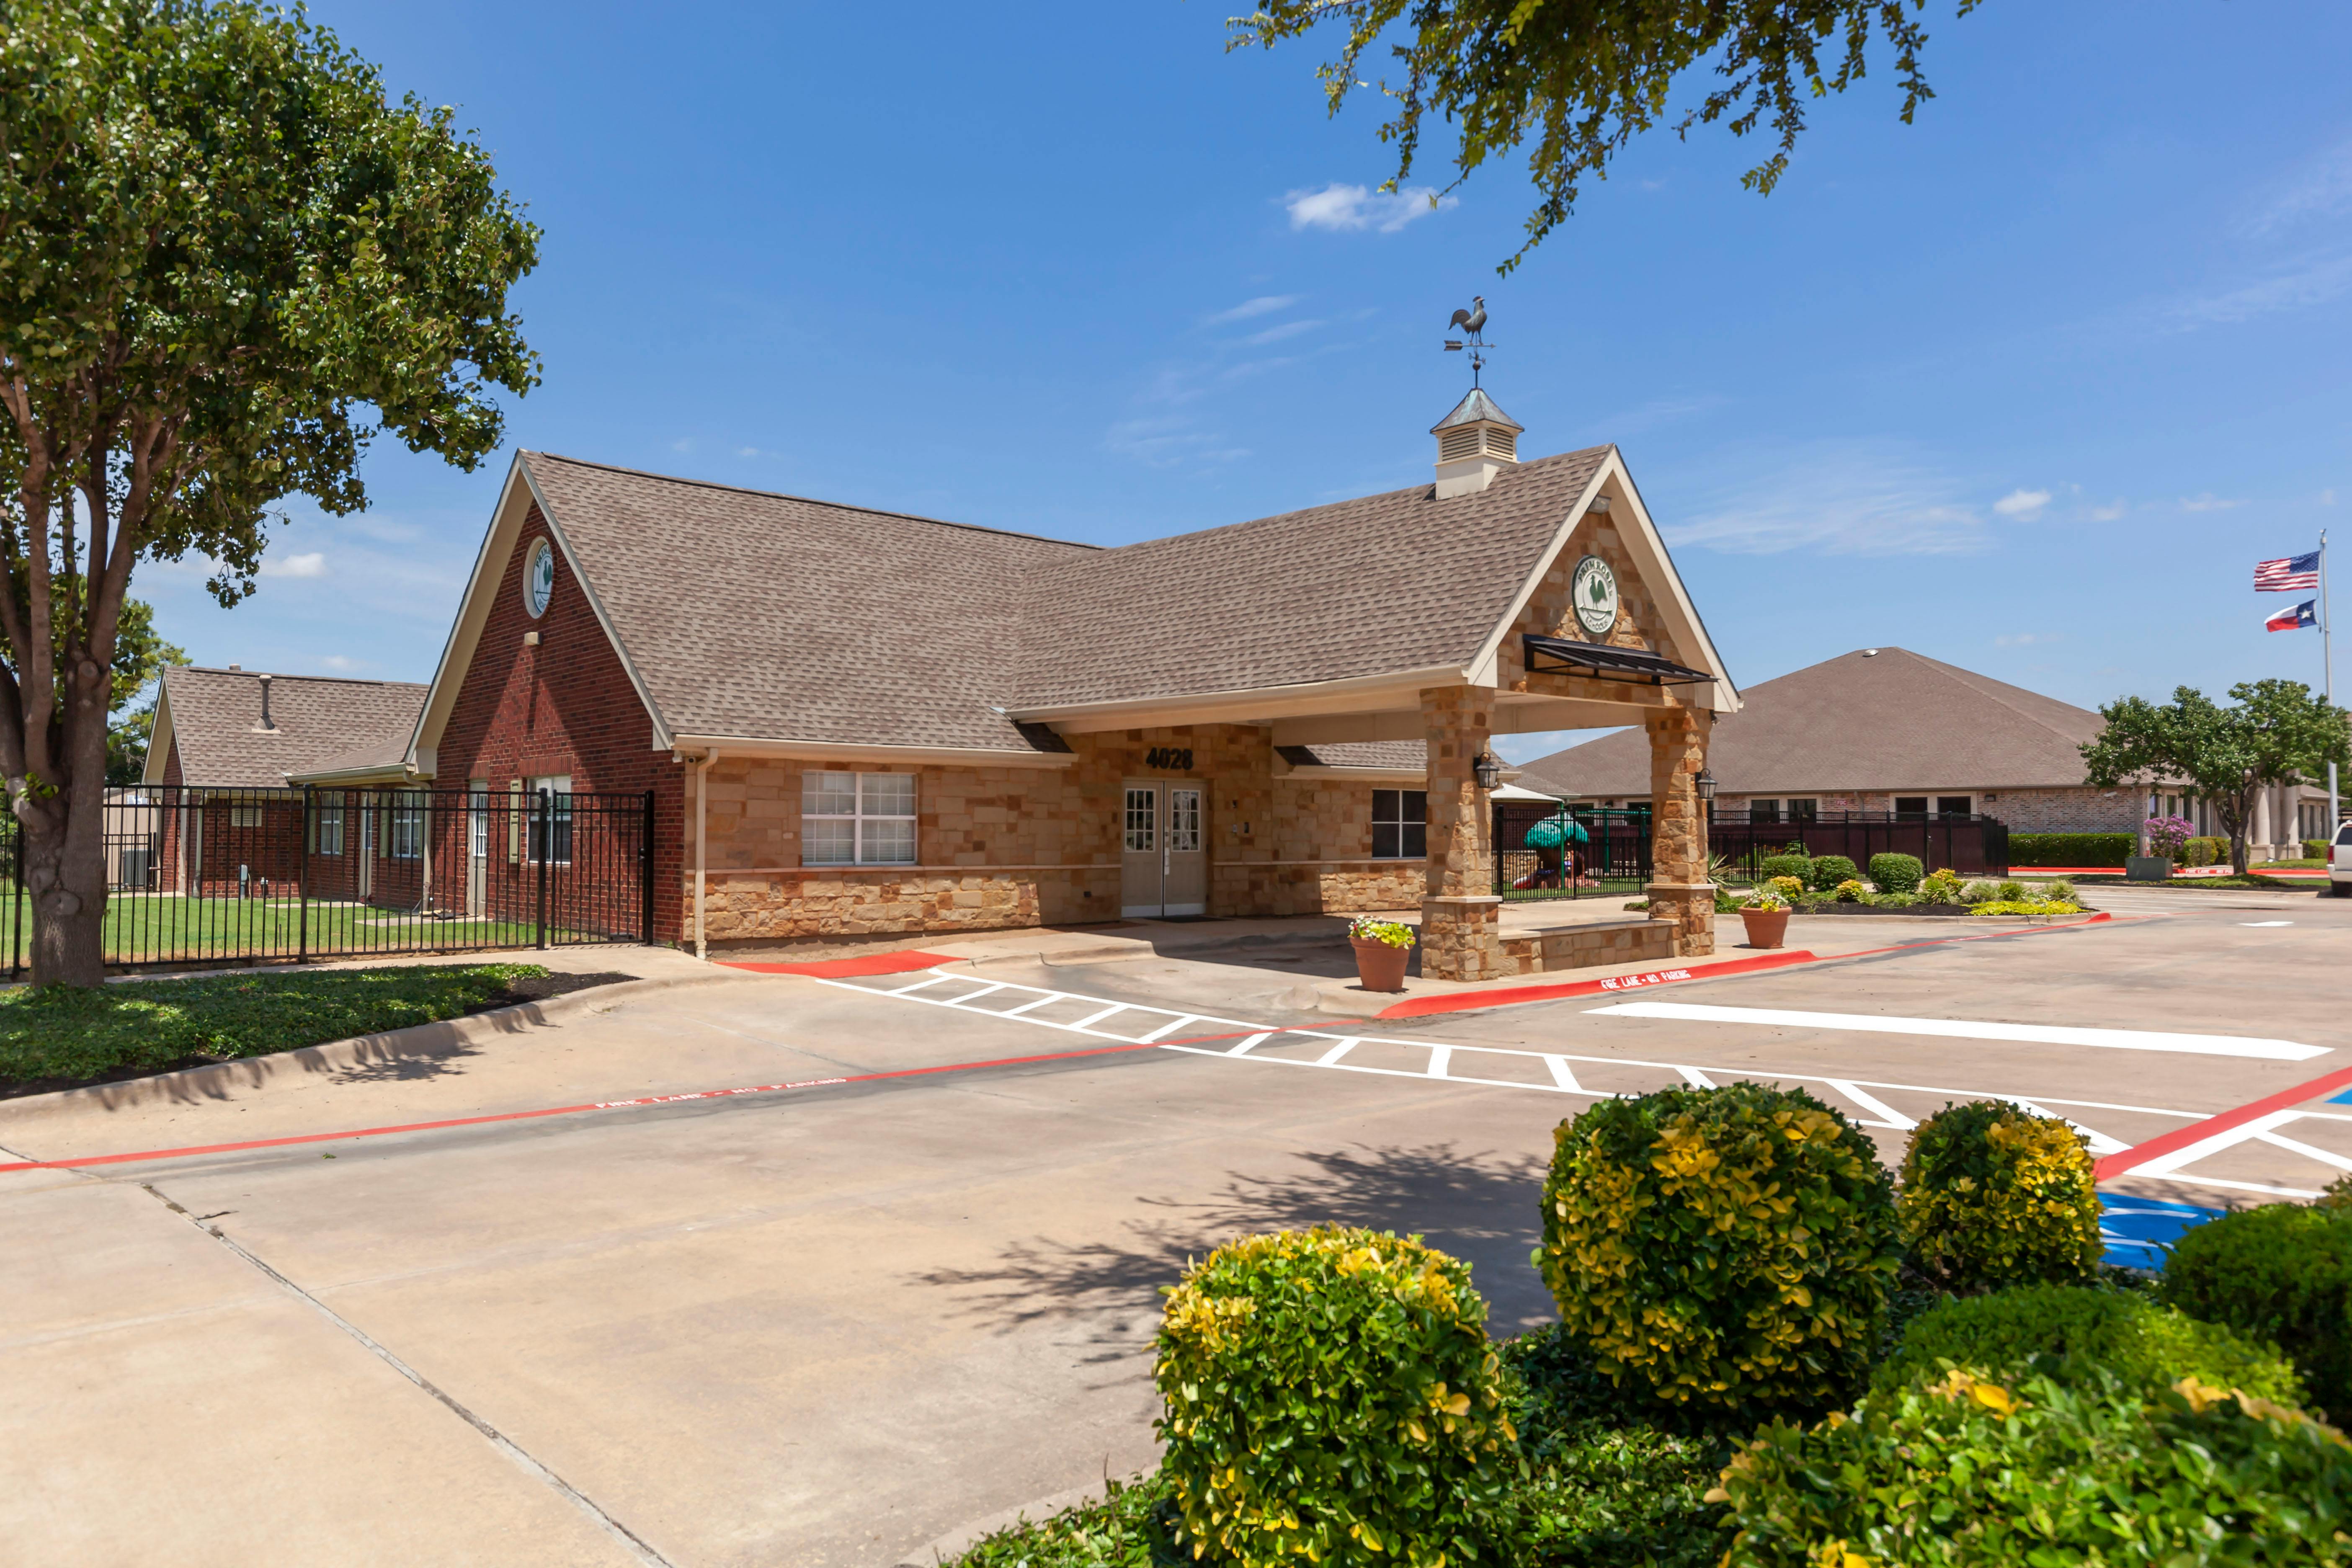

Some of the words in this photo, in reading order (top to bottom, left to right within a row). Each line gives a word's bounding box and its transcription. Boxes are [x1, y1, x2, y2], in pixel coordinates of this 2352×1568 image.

[1578, 561, 1613, 585] PRIMROSE
[1146, 746, 1194, 770] 4028
[1601, 978, 1620, 989] FIRE
[1620, 976, 1642, 987] LANE
[1645, 974, 1660, 983] NO
[1660, 970, 1691, 981] PARKING
[595, 1100, 642, 1108] FIRE
[652, 1093, 707, 1102] LANE
[770, 1078, 846, 1089] PARKING
